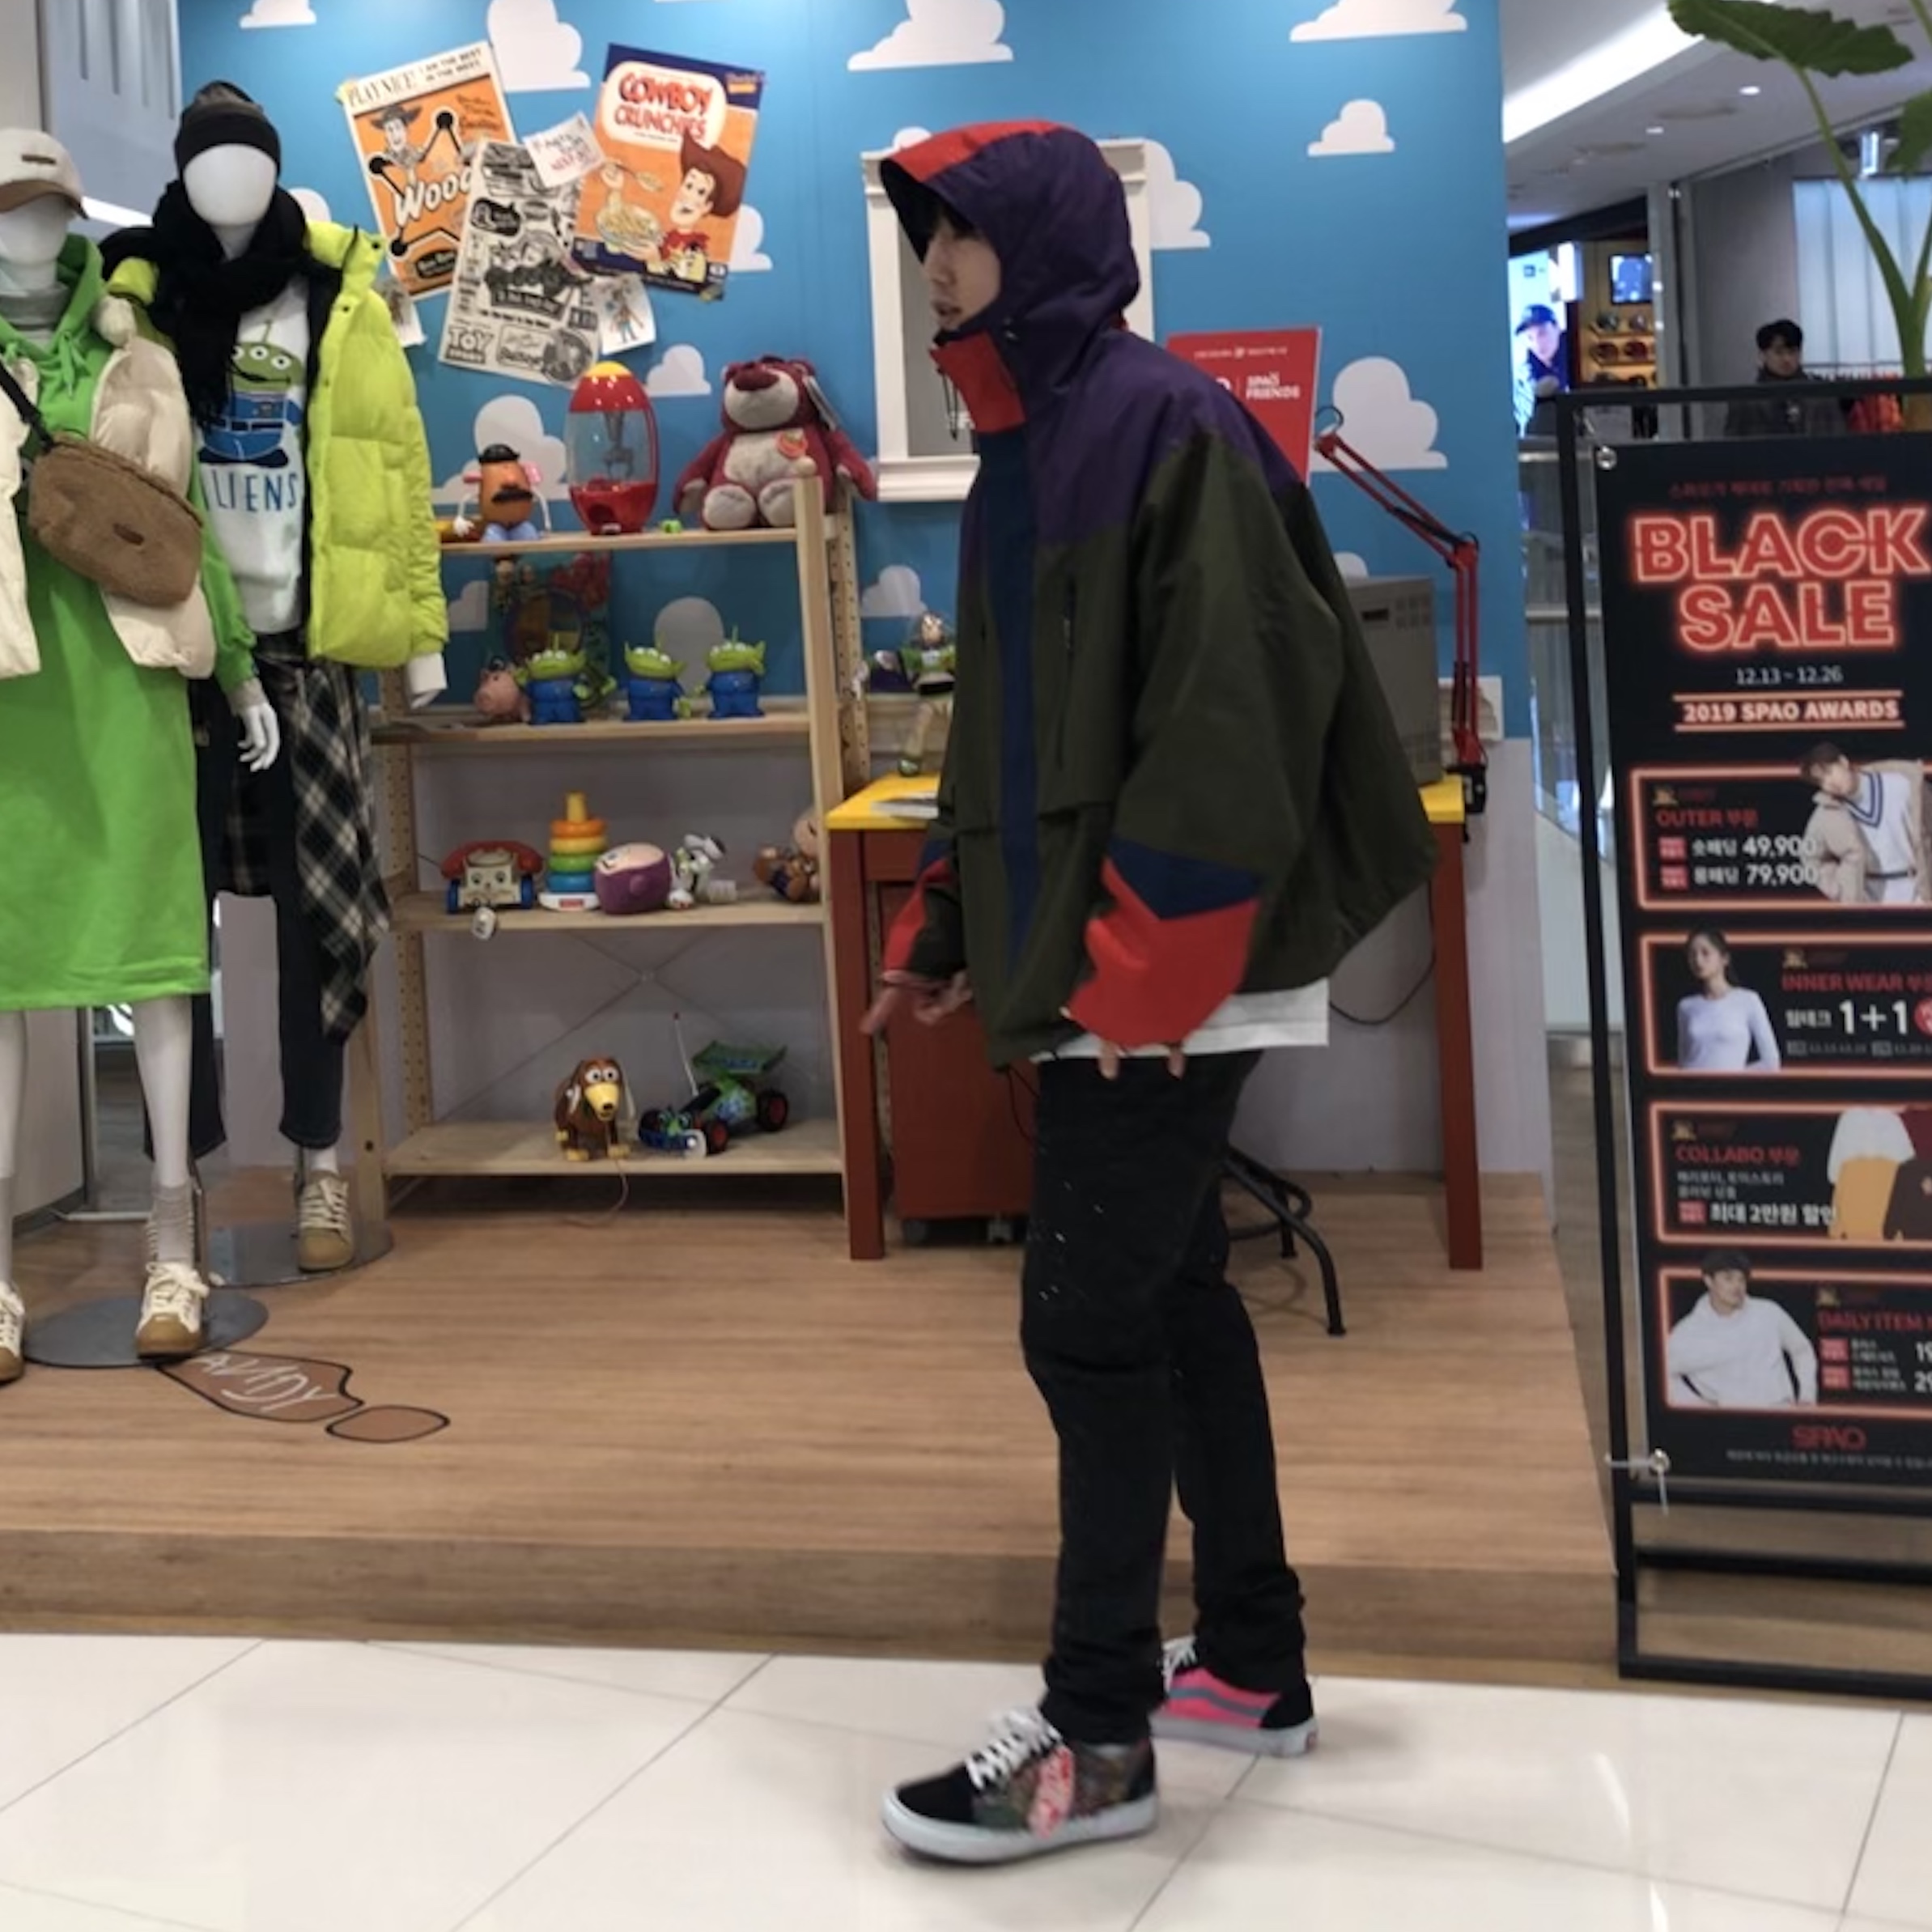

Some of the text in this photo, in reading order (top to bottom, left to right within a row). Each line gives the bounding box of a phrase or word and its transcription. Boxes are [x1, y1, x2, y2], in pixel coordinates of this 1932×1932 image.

[618, 72, 714, 116] COWBOY
[448, 325, 494, 351] TOY
[1632, 506, 1932, 583] BLACK
[1679, 580, 1896, 651] SALE
[1683, 699, 1900, 724] 2019 SPAO AWARDS
[1655, 809, 1723, 827] OUTER
[1742, 834, 1818, 859] 49,900
[1745, 863, 1819, 888] 79,900
[1781, 973, 1843, 992] INNER
[1845, 972, 1903, 992] WEAR
[1838, 998, 1909, 1035] 1+1
[1675, 1144, 1764, 1164] COLLABO
